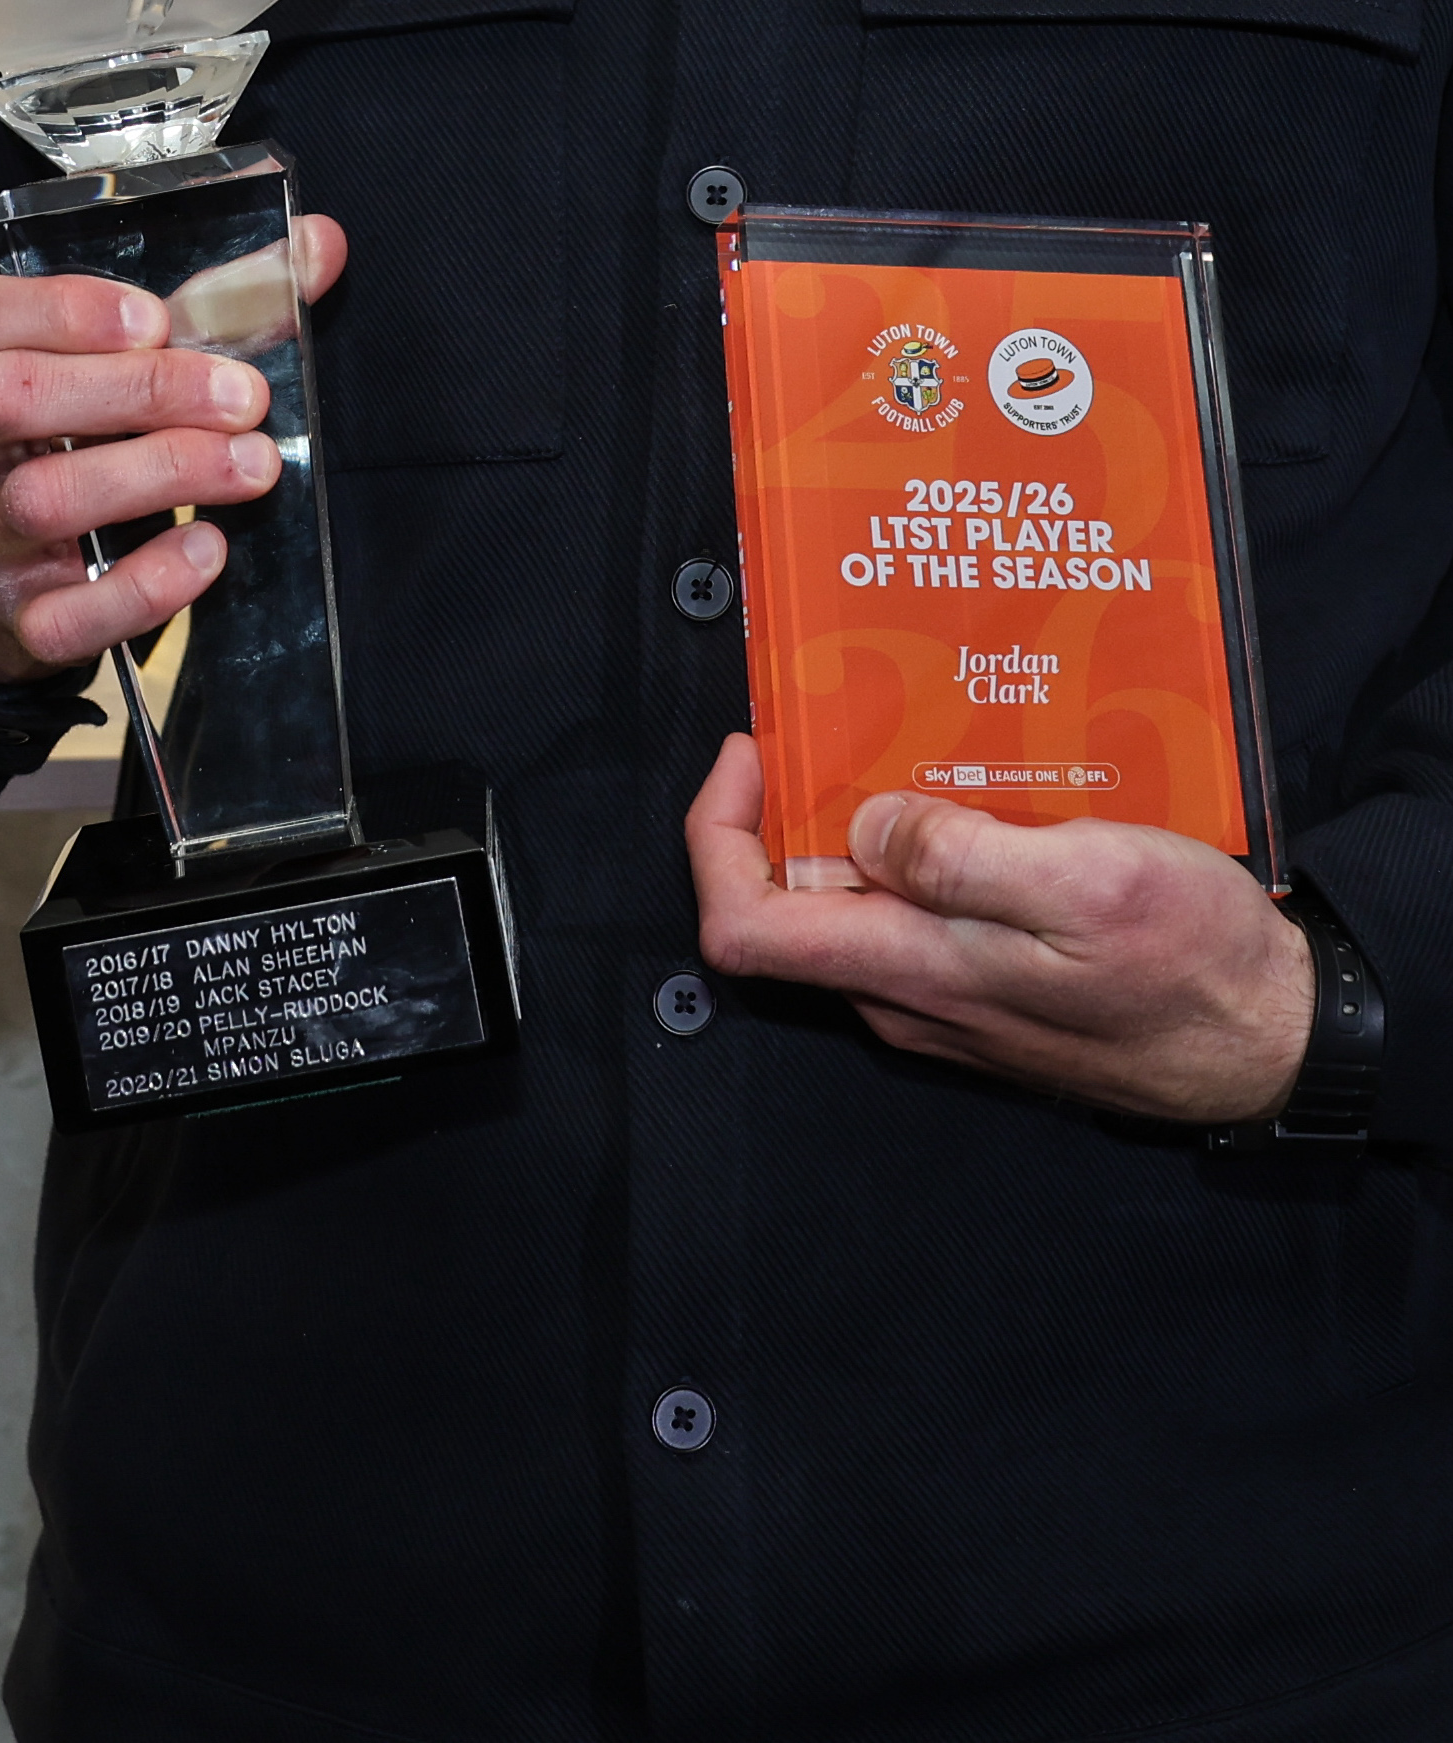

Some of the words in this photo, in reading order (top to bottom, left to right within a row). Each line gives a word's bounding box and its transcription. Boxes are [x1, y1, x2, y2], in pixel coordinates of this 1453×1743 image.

[867, 323, 912, 357] LUTON
[916, 324, 959, 359] TOWN
[999, 336, 1037, 362] LUTON
[1041, 336, 1077, 364] TOWN
[871, 396, 936, 433] FOOTBALL
[935, 398, 965, 428] CLUB
[1059, 404, 1083, 426] TRUST
[904, 479, 1074, 518] 2025/26
[870, 516, 952, 550] LTST
[965, 518, 1114, 553] PLAYER
[840, 552, 895, 587] OF
[906, 554, 980, 588] THE
[992, 556, 1152, 591] SEASON
[954, 644, 1059, 682] Jordan
[967, 675, 1050, 704] Clark
[924, 767, 952, 784] sky
[956, 767, 983, 782] bet
[989, 770, 1034, 782] LEAGUE
[1035, 770, 1059, 782] ONE
[1087, 770, 1109, 782] EFL
[86, 944, 171, 978] 2016/17
[185, 927, 260, 959] DANNY
[270, 911, 357, 945] HYLTON
[90, 971, 174, 1002] 2017/18
[193, 957, 251, 985] ALAN
[261, 936, 367, 972] SHEEHAN
[96, 995, 181, 1027] 2018/19
[195, 983, 250, 1010] JACK
[258, 966, 340, 998] STACEY
[99, 1018, 192, 1051] 2019/20
[198, 985, 389, 1035] PELLY-RUDDOCK
[203, 1026, 297, 1058] MPANZU
[106, 1065, 198, 1098] 2020/21
[207, 1052, 279, 1082] SIMON
[290, 1038, 366, 1068] SLUGA
